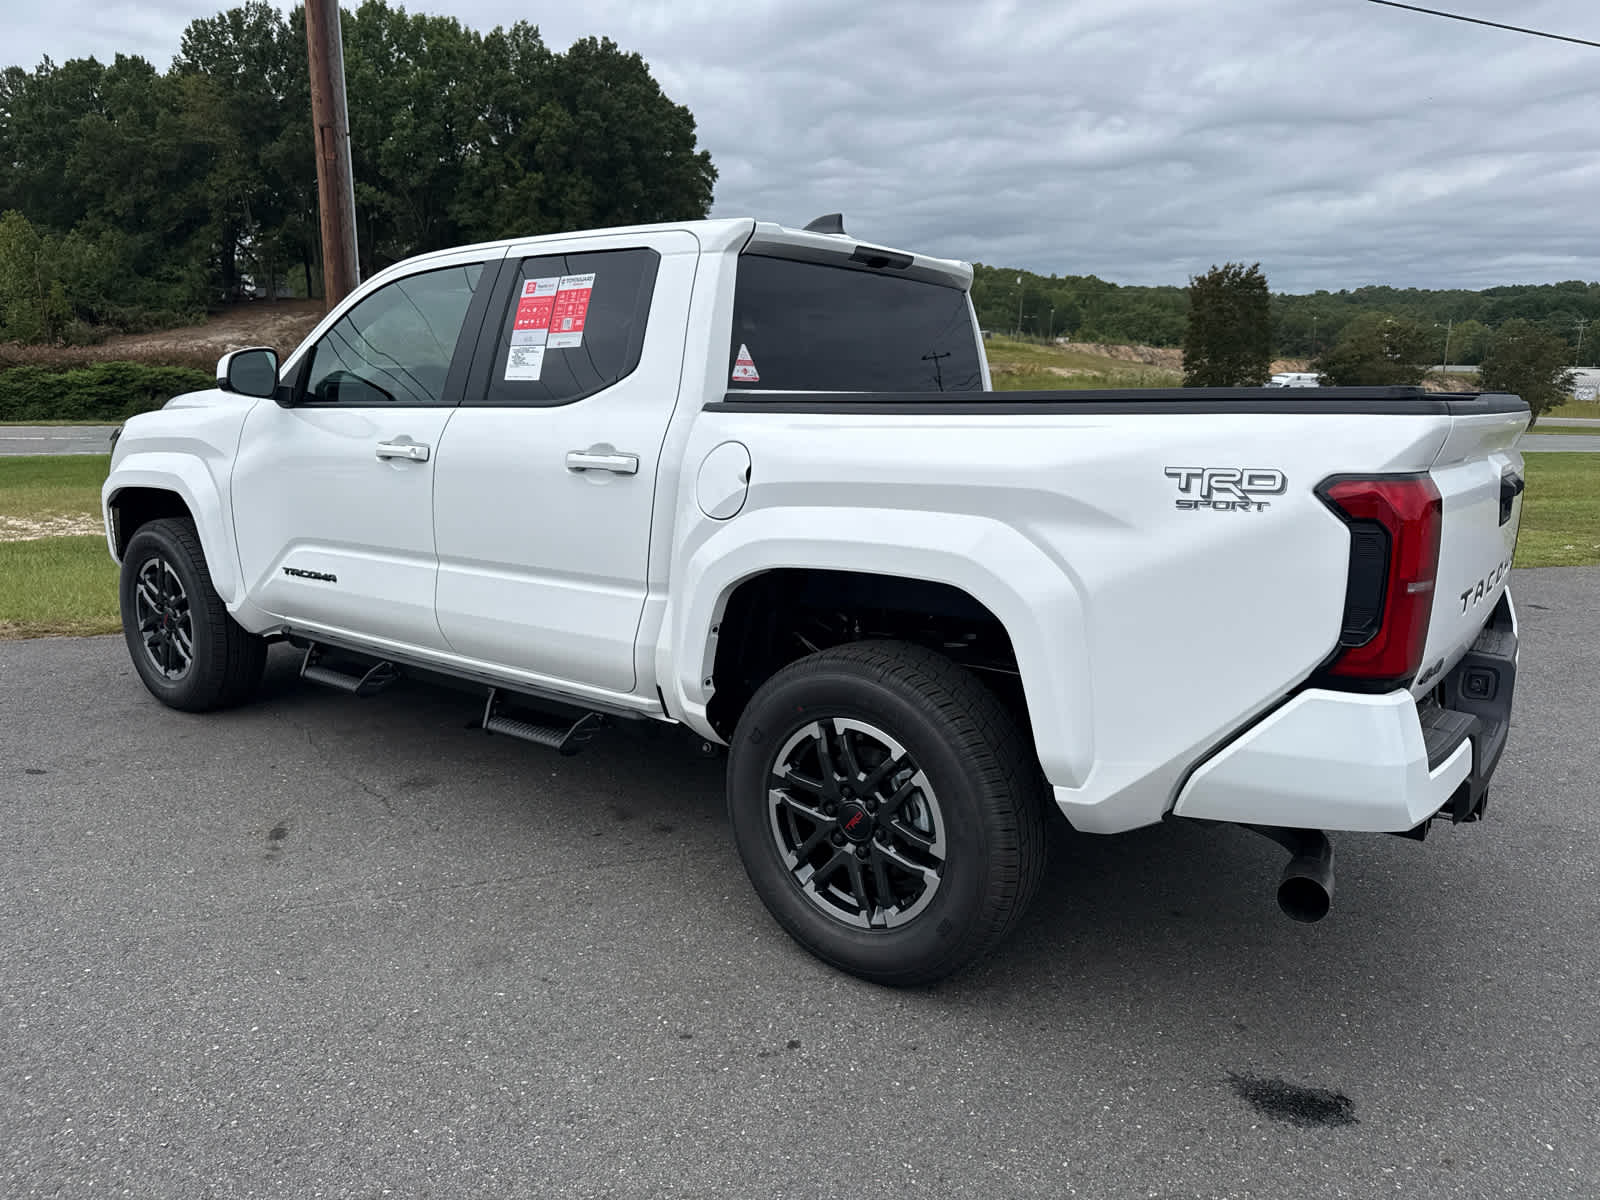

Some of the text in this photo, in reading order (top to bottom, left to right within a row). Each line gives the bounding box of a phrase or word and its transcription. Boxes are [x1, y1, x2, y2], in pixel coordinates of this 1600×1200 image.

[1164, 466, 1288, 502] TRD
[1176, 500, 1271, 512] SPORT
[282, 566, 338, 584] TACOMA
